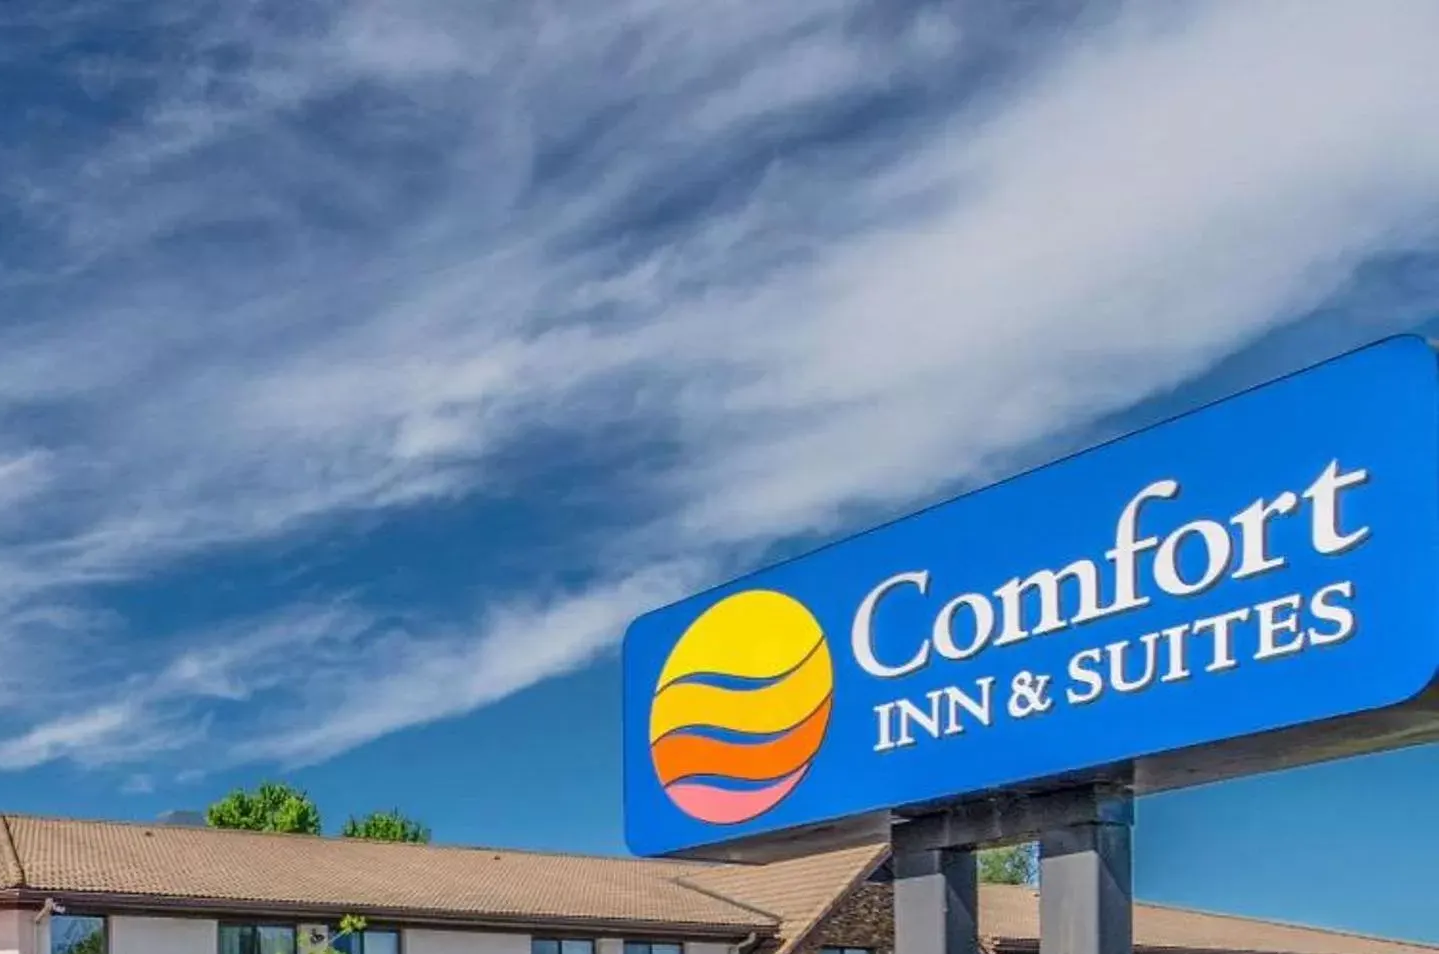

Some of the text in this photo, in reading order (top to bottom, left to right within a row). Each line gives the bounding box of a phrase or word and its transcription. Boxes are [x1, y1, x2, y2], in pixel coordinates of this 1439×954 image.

[850, 458, 1369, 678] Comfort
[873, 580, 1355, 752] INN & SUITES
